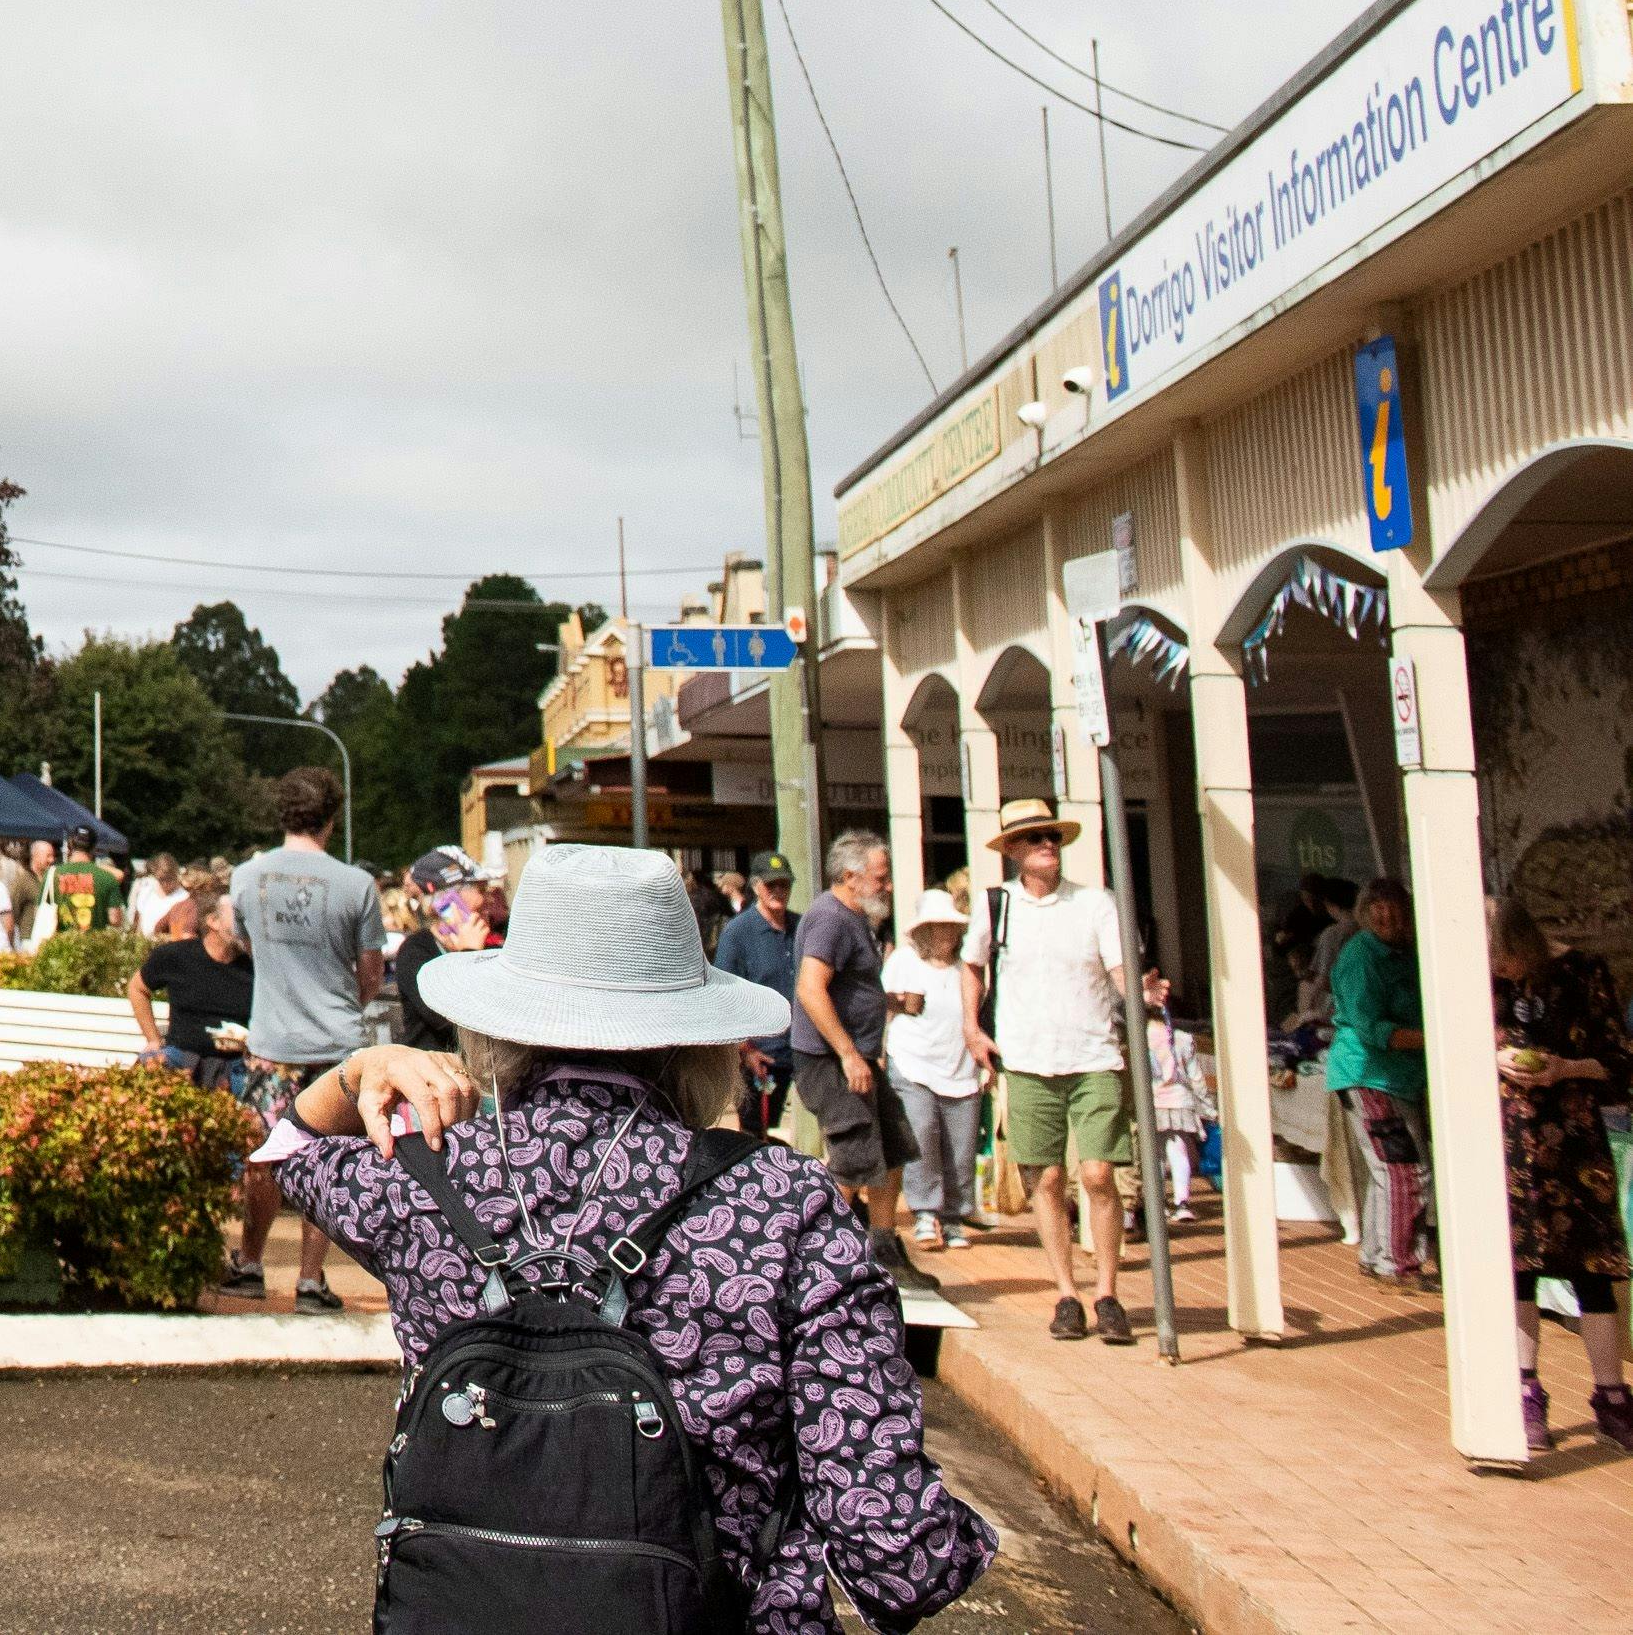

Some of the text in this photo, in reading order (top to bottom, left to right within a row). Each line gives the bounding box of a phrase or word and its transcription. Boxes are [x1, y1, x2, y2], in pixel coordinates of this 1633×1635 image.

[1125, 259, 1196, 354] Dorrigo
[1195, 202, 1264, 302] Visitor
[1267, 76, 1429, 251] Information
[1297, 835, 1336, 868] ths
